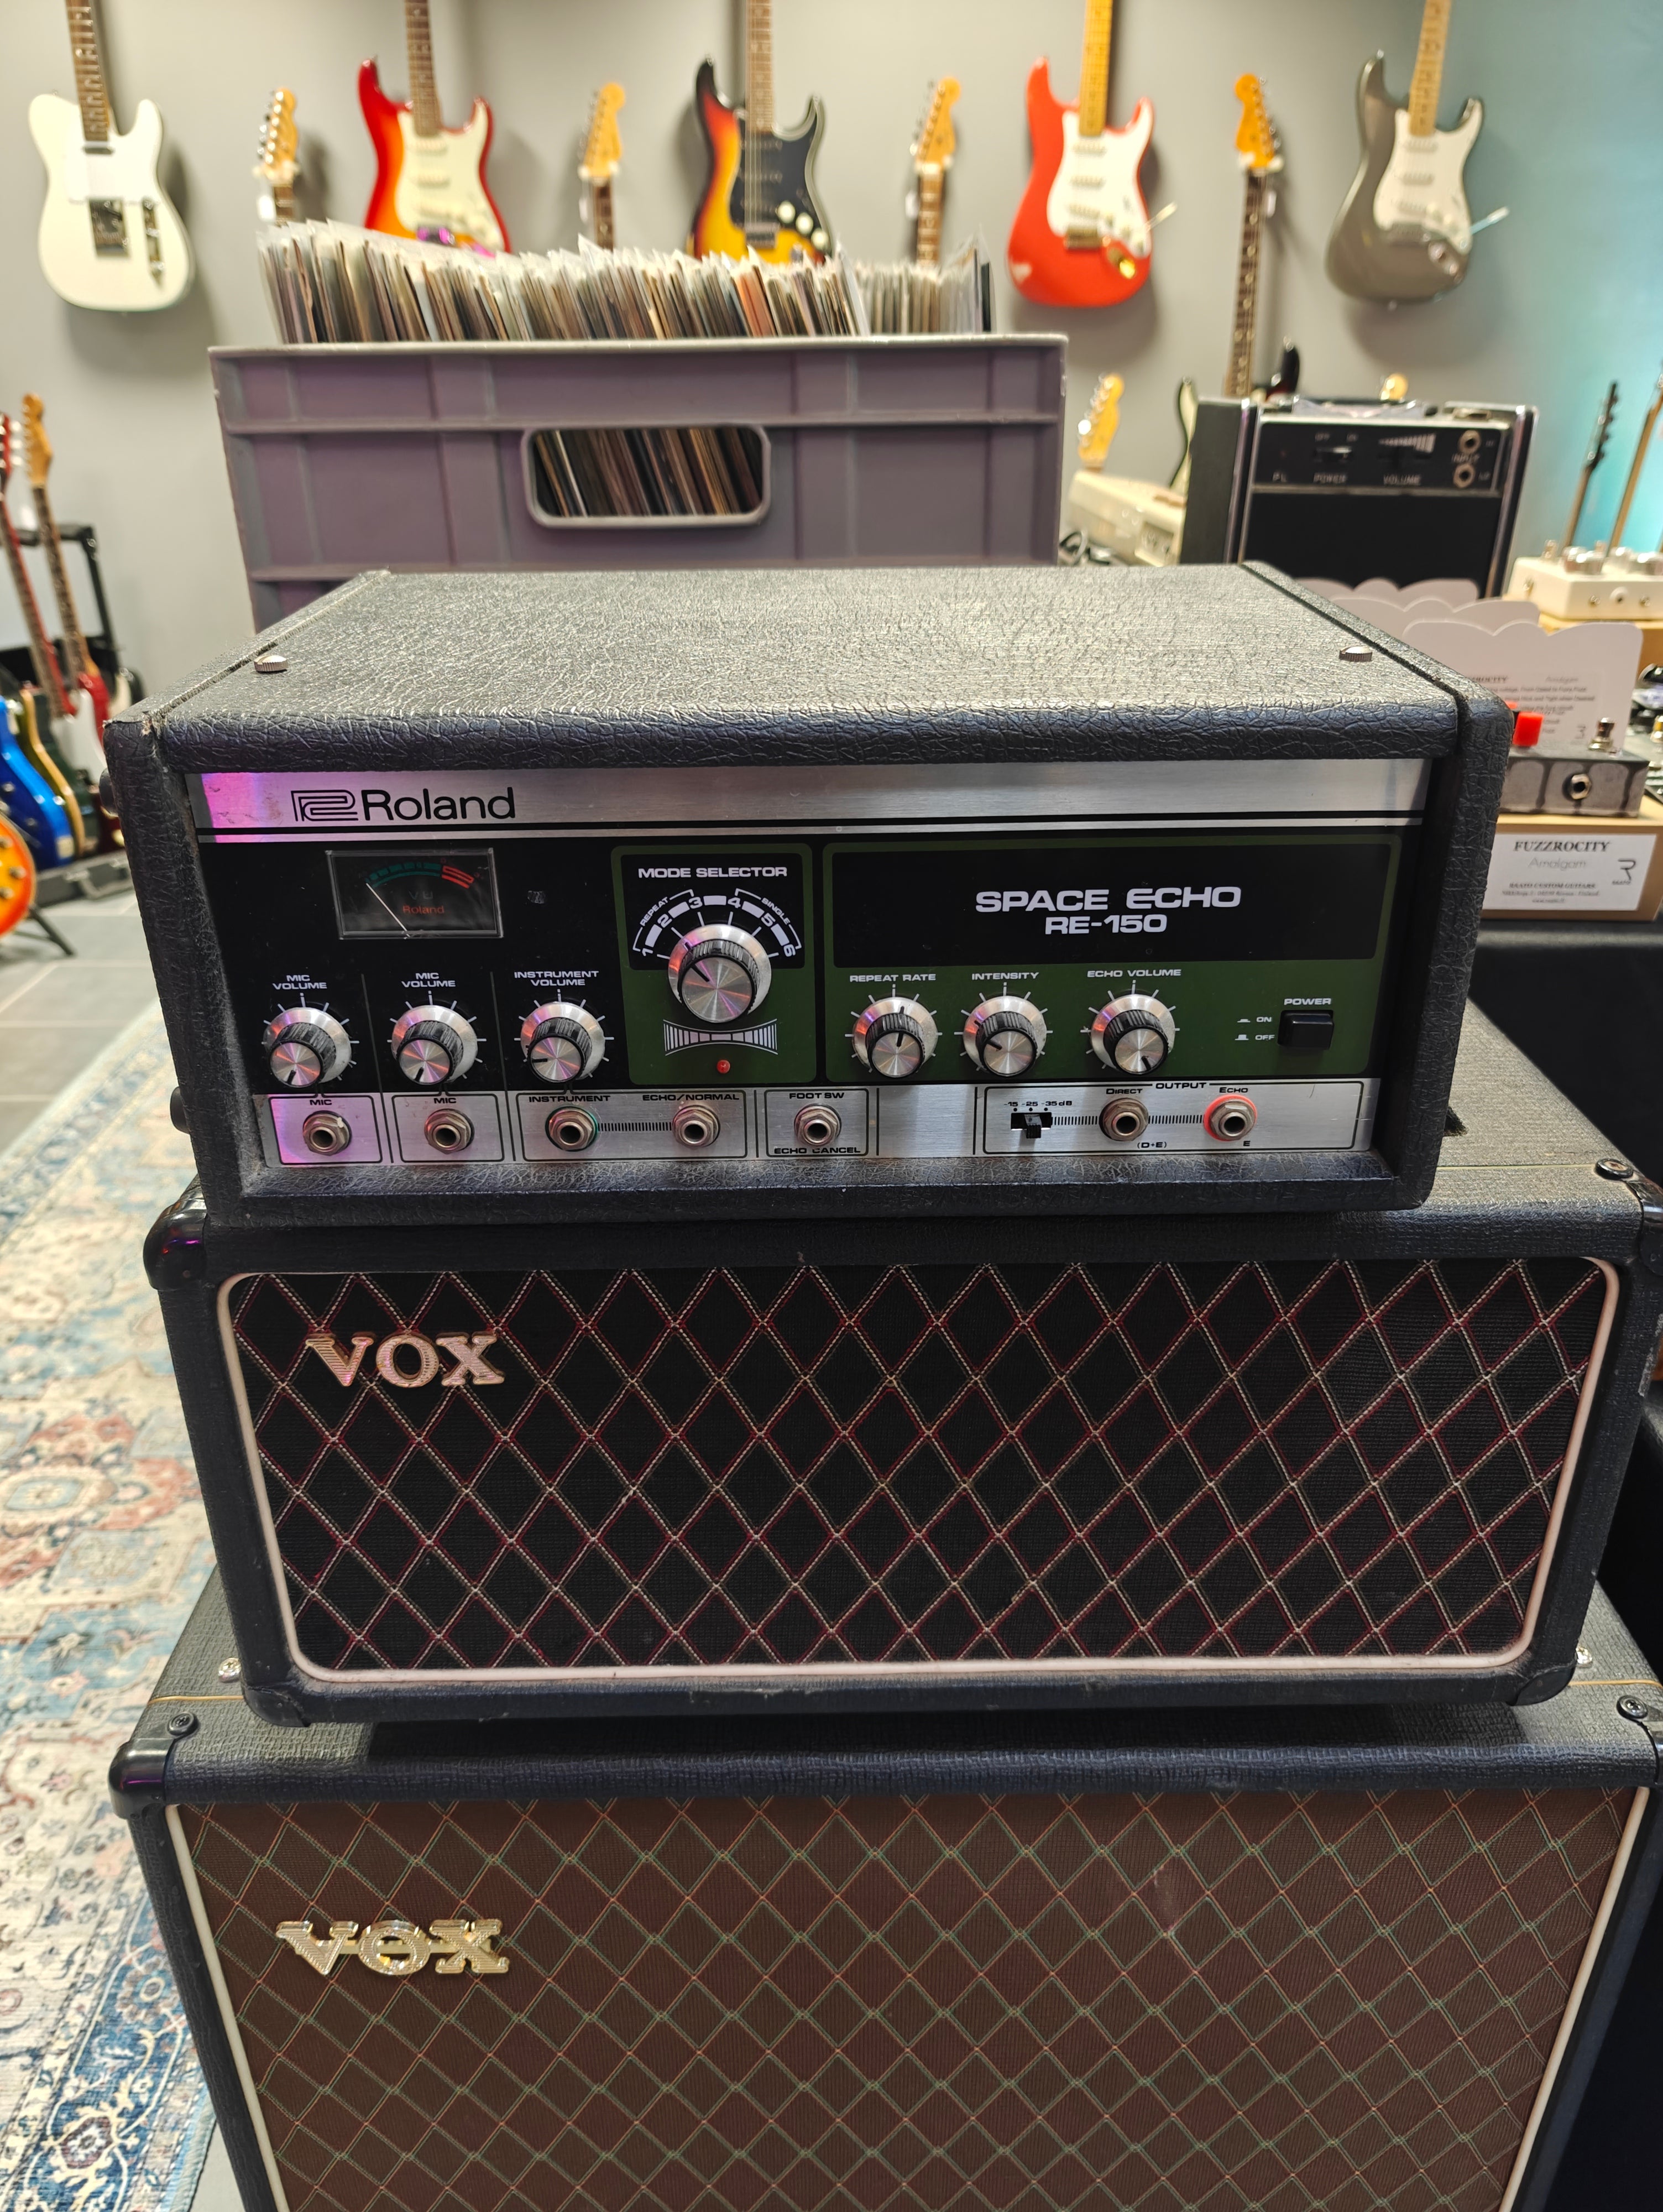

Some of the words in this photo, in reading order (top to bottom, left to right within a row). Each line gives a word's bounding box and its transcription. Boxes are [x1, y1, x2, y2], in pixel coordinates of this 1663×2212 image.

[1383, 474, 1421, 486] VOLUME
[361, 787, 516, 821] Roland
[1513, 841, 1610, 852] FUZZROCITY
[1528, 858, 1587, 871] Amalgam
[638, 868, 691, 878] MODE
[696, 867, 787, 878] SELECTOR
[688, 896, 703, 909] 3
[728, 897, 741, 909] 4
[976, 889, 1110, 912] SPACE
[1126, 886, 1241, 910] ECHO
[402, 905, 445, 914] Roland
[639, 896, 668, 926] REPEAT
[761, 898, 791, 925] SINGLE
[657, 914, 672, 928] 2
[761, 912, 776, 927] 5
[1045, 914, 1168, 935] RE-150
[642, 948, 653, 956] 1
[783, 945, 796, 957] 6
[902, 973, 936, 982] RATE
[971, 972, 1039, 980] INTENSITY
[1127, 969, 1181, 977] VOLUME
[642, 1092, 740, 1101] ECHO/NORMAL
[306, 1332, 505, 1388] VOX
[276, 1919, 510, 1976] VOX
